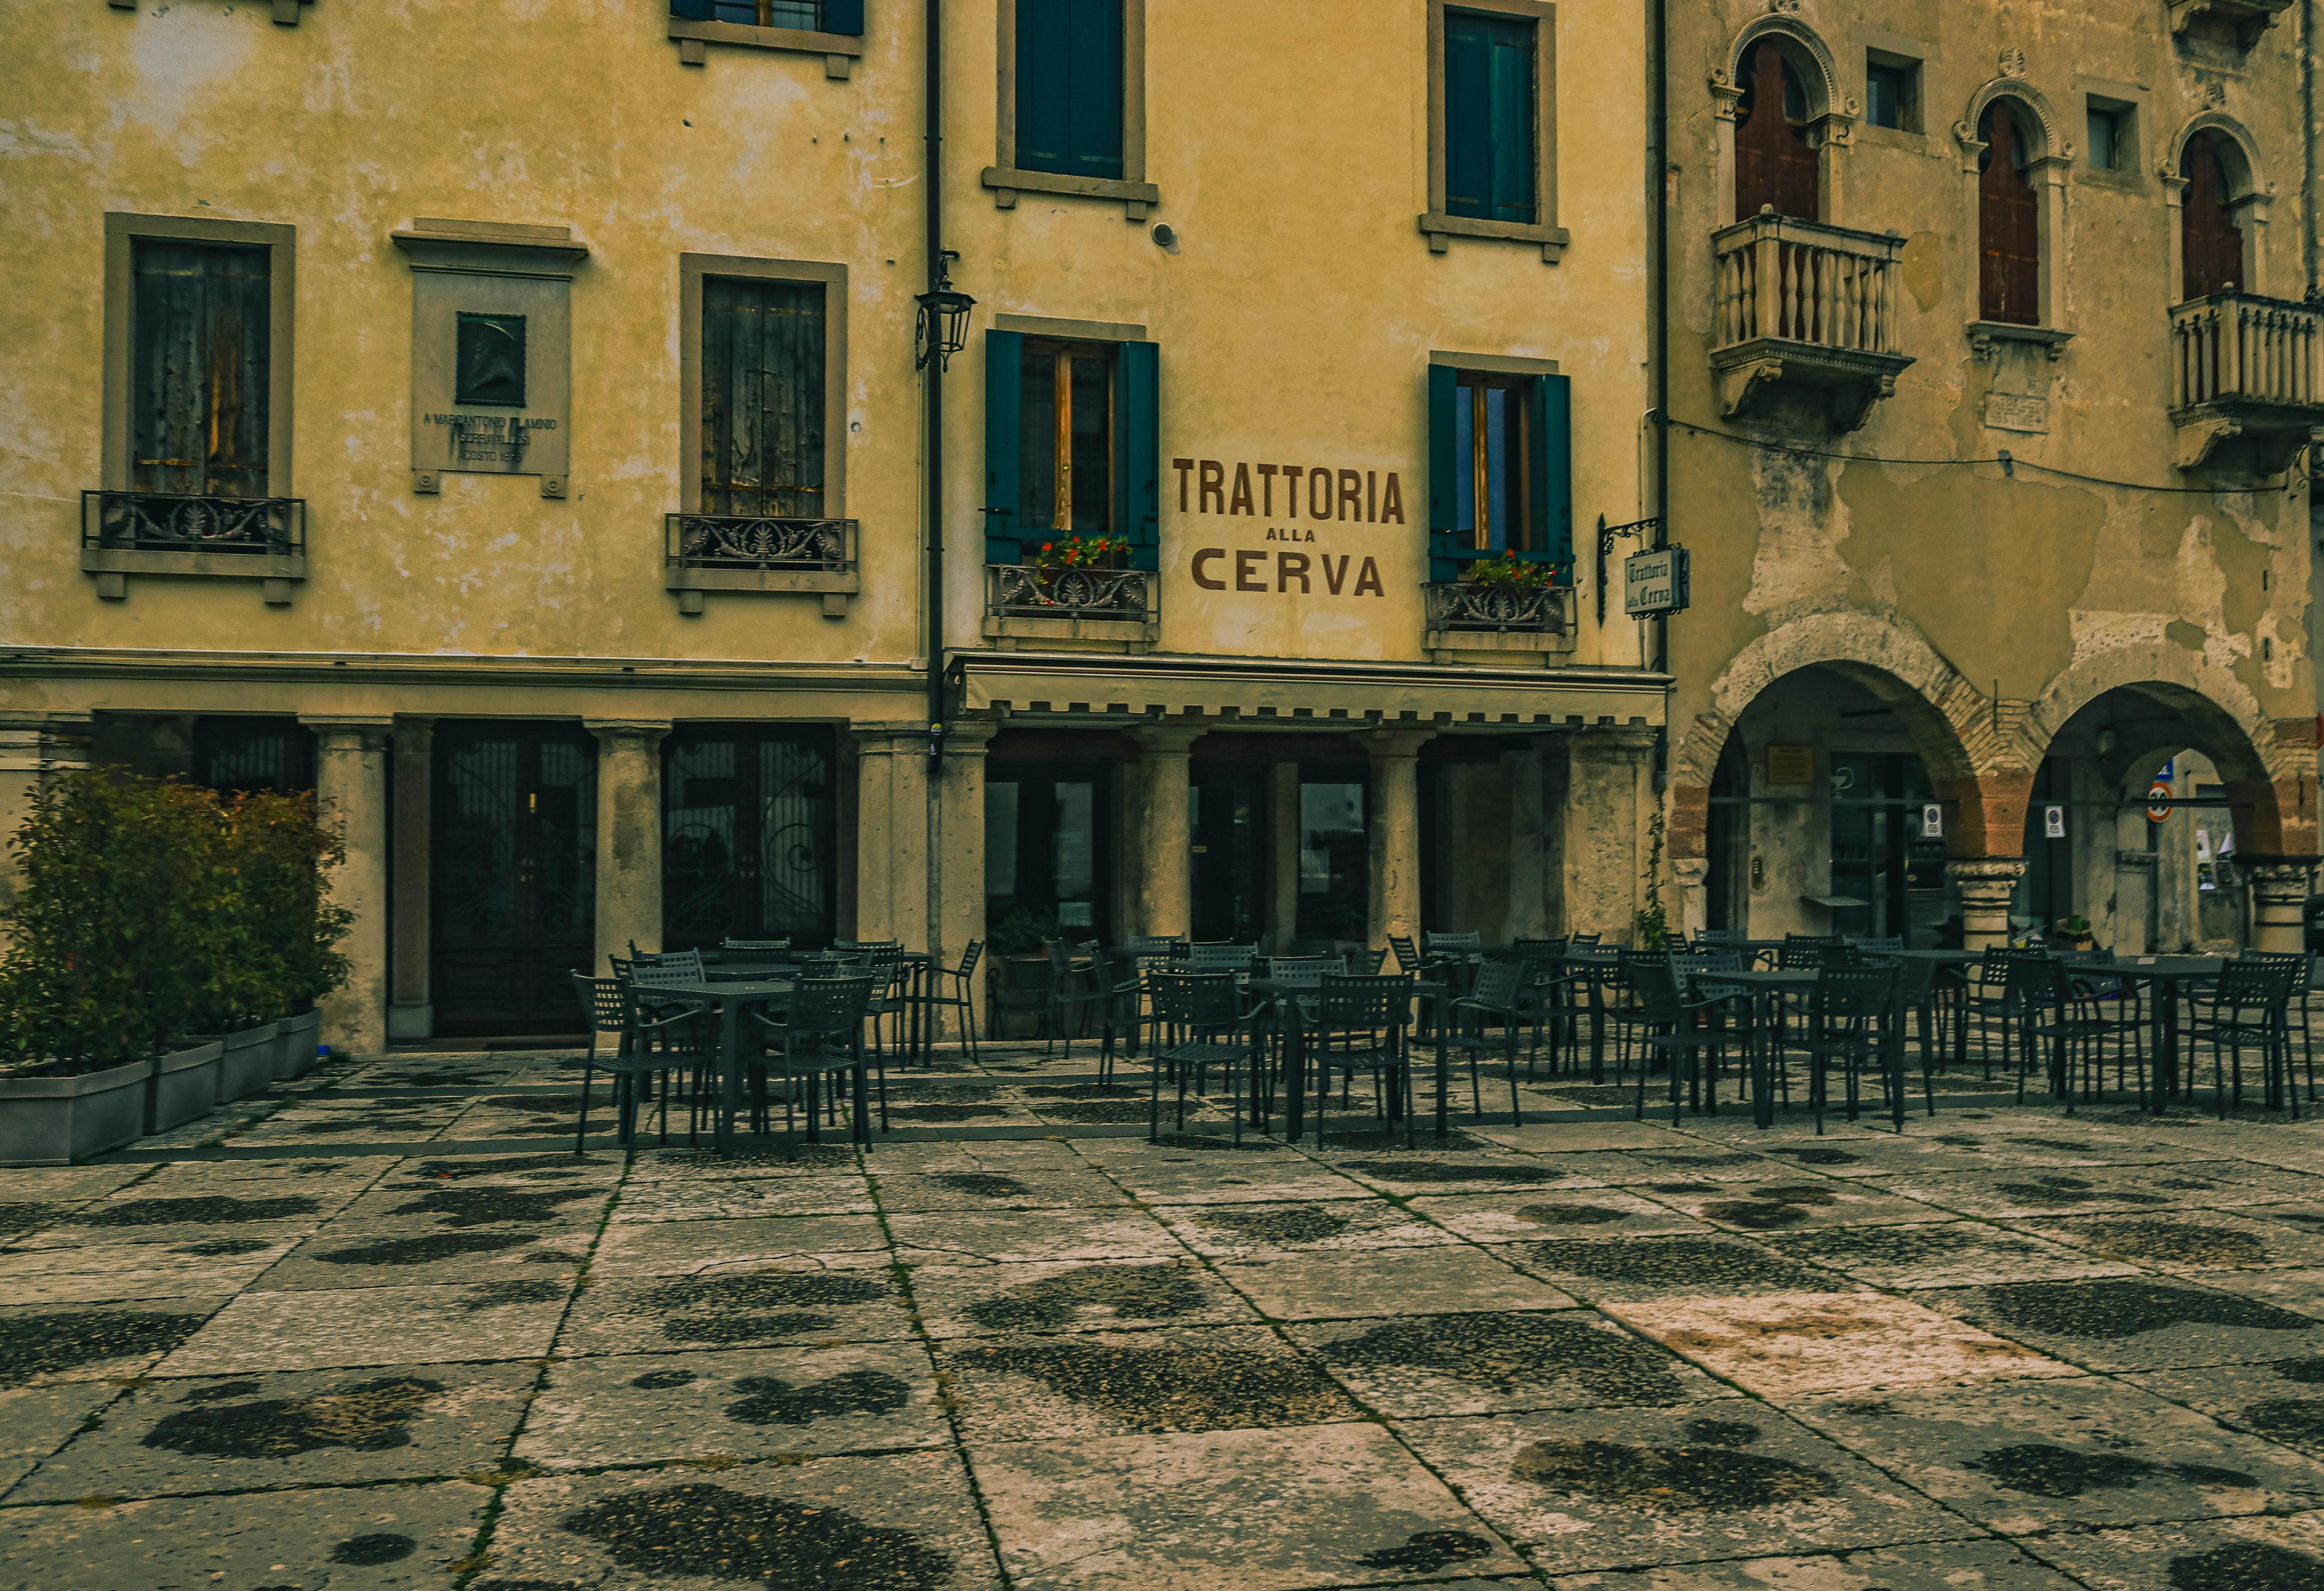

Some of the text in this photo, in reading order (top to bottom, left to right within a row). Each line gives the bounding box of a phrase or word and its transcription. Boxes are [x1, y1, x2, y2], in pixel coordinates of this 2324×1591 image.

[1172, 458, 1405, 525] TRATTORIA
[1265, 527, 1316, 543] ALLA
[1191, 547, 1385, 597] CERVA
